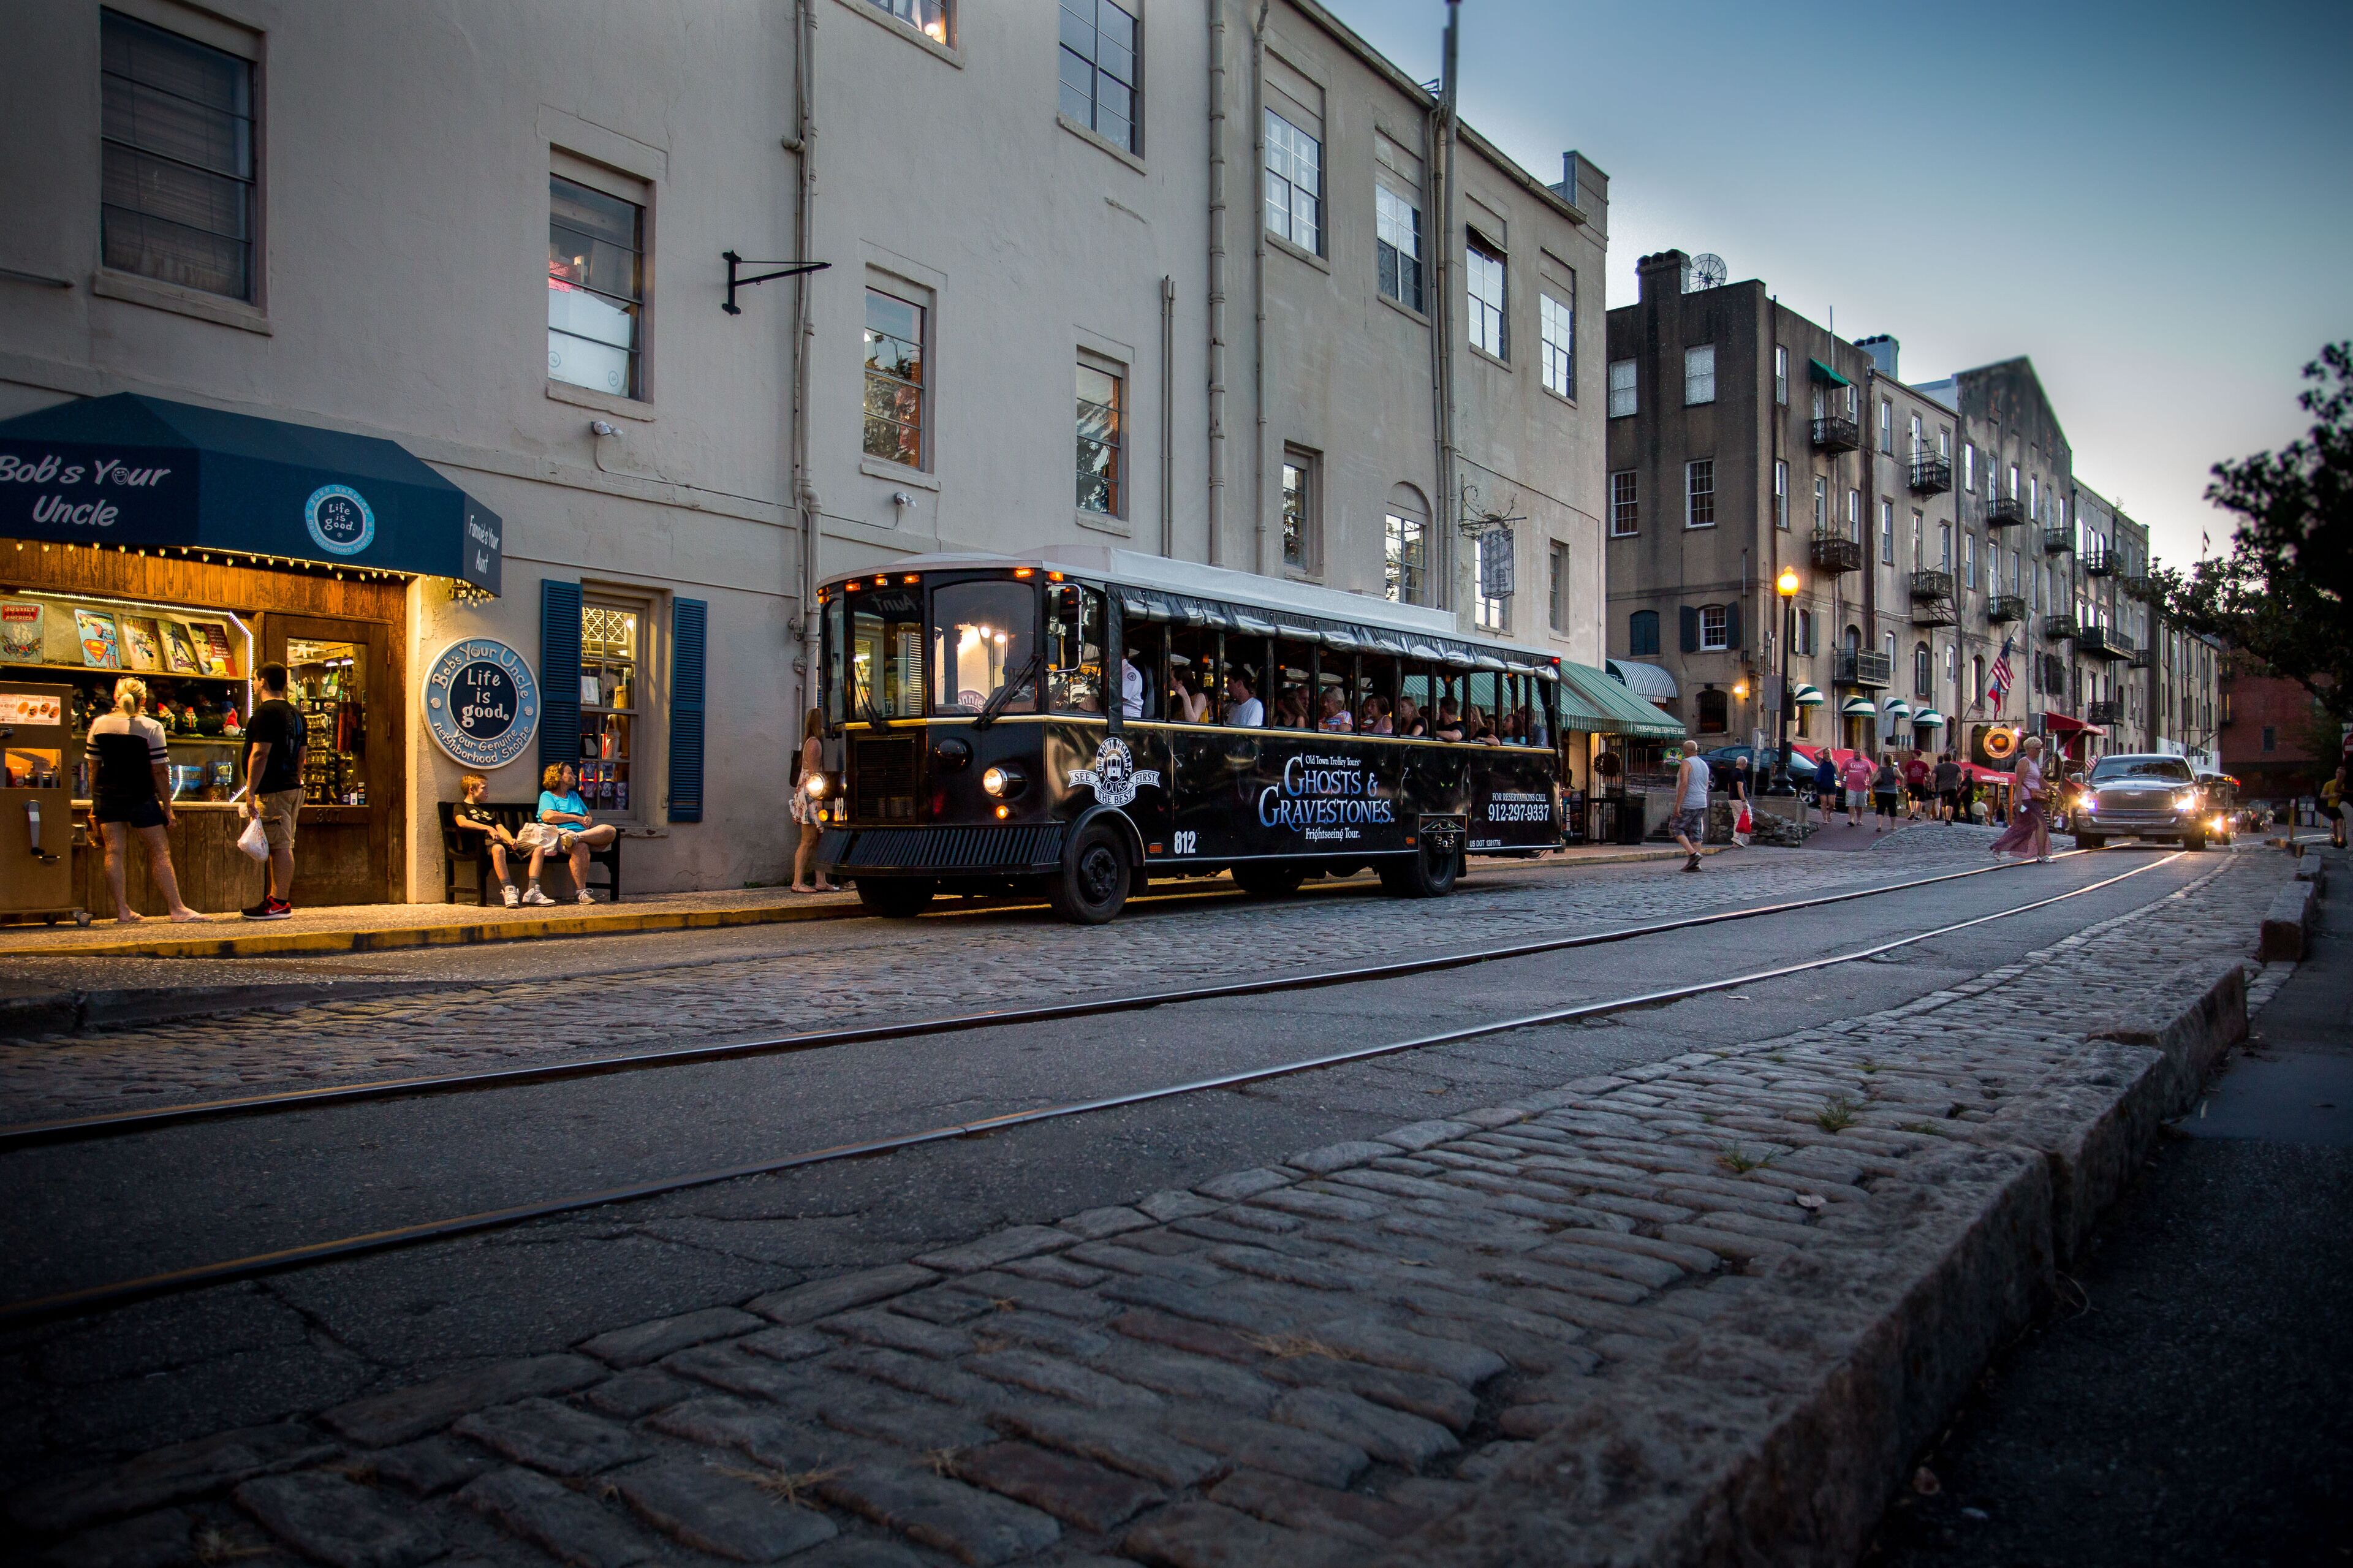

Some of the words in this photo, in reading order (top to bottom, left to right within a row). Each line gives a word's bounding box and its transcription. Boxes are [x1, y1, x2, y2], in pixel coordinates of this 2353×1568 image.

[0, 455, 85, 483] Bob's
[32, 495, 119, 526] Uncle
[328, 502, 350, 515] Life
[469, 515, 488, 545] Fannie's
[488, 527, 499, 550] Your
[476, 549, 488, 574] Aunt
[432, 656, 462, 689] Bob's
[460, 643, 497, 661] Your
[500, 648, 531, 699] Uncle
[467, 668, 501, 686] Life
[476, 688, 490, 704] is
[462, 703, 509, 728] good.
[434, 722, 498, 763] neighborhood
[502, 726, 530, 758] Shoppe
[479, 730, 517, 751] Genuine
[1100, 739, 1114, 756] TOWN
[1116, 739, 1132, 772] TROLLEY
[1305, 755, 1315, 764] Old
[1316, 756, 1329, 765] Town
[1330, 756, 1346, 768] Trolley
[1075, 773, 1090, 781] SEE
[1102, 776, 1127, 792] TOURS
[1136, 773, 1156, 782] FIRST
[1284, 753, 1362, 797] GHOSTS
[1367, 773, 1378, 797] &
[1097, 790, 1112, 803] THE
[1114, 790, 1132, 804] BEST
[1259, 782, 1392, 832] GRAVESTONES
[1502, 793, 1535, 801] RESERVATIONS
[1488, 804, 1549, 821] 912-297-9337
[1174, 831, 1195, 854] 812
[1305, 827, 1343, 842] Frightseeing
